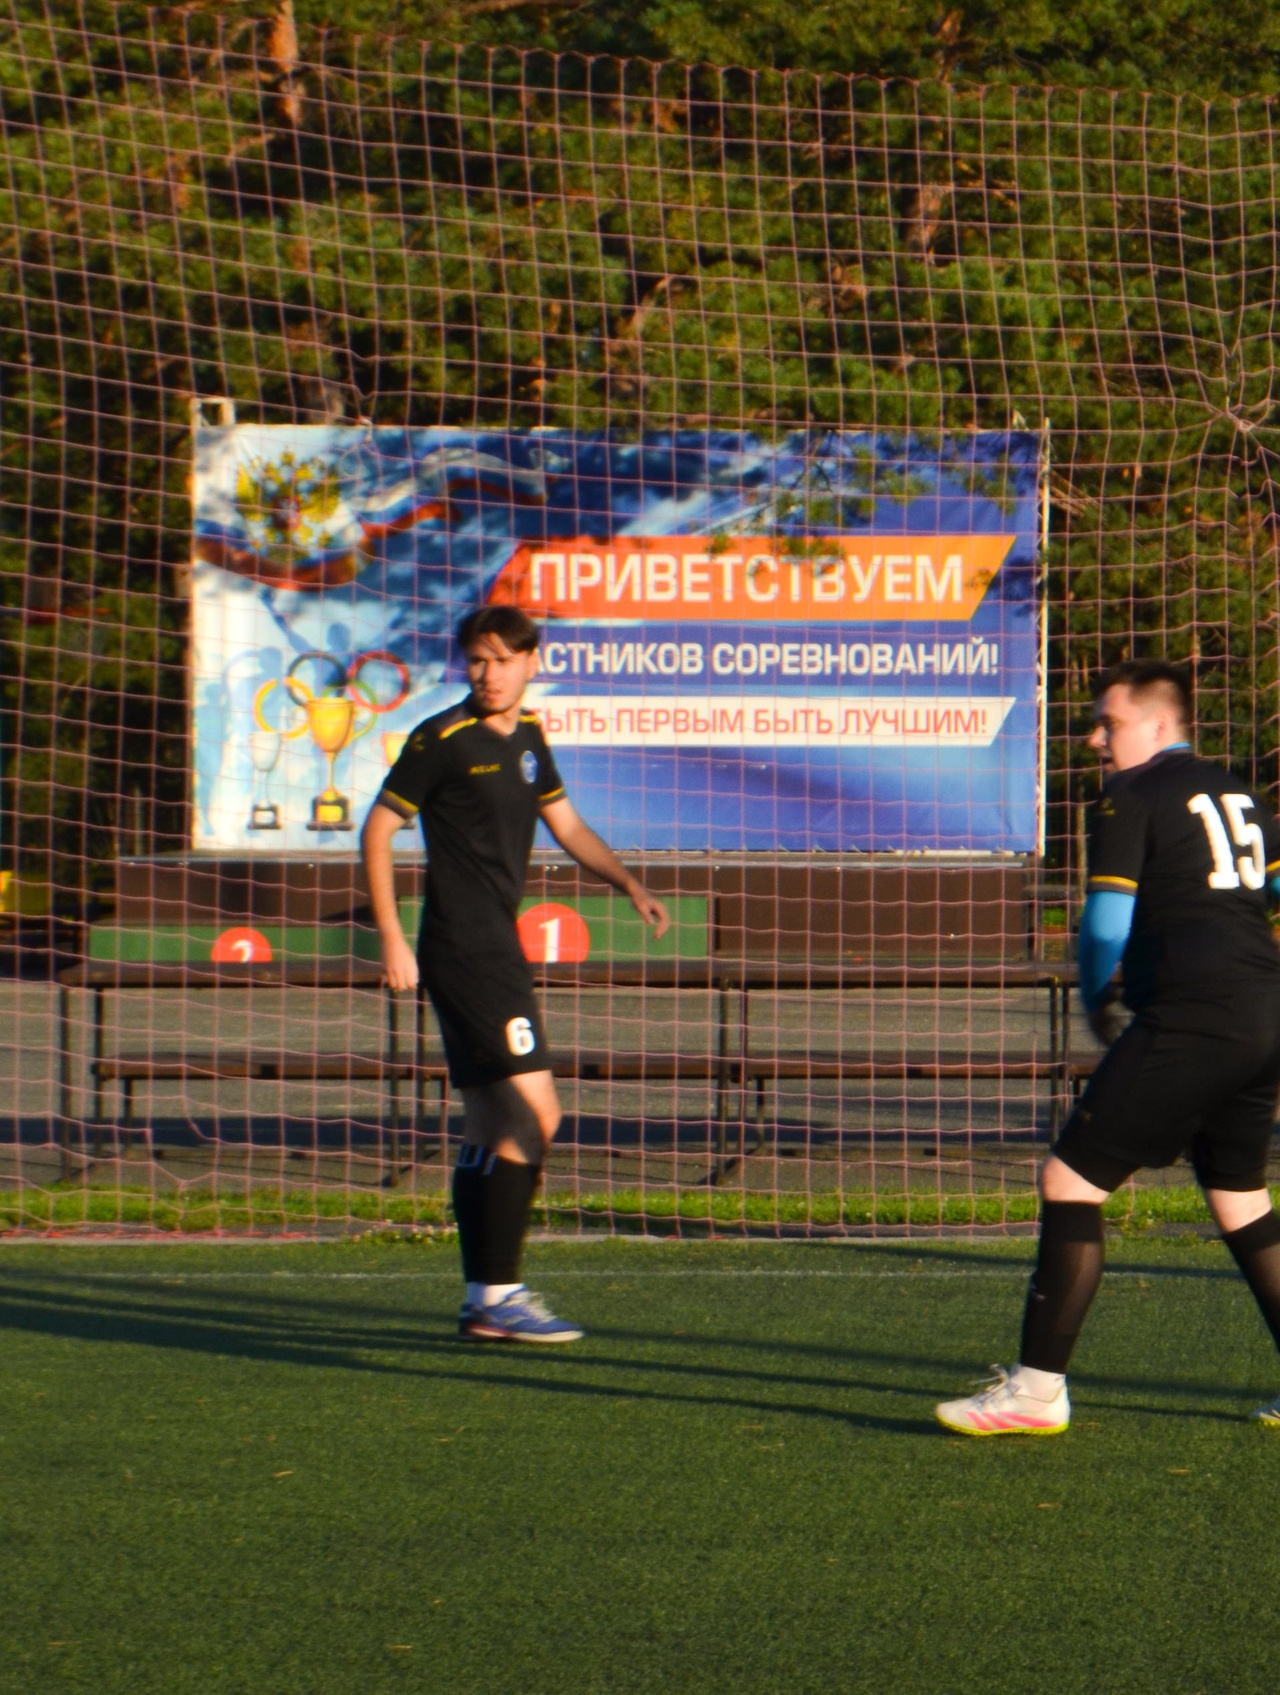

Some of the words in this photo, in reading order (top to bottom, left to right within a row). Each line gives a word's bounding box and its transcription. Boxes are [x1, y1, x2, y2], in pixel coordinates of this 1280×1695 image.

[531, 553, 963, 602] ПРИВЕТСТВУЕМ
[712, 636, 999, 675] СОРЕВНОВАНИЙ!
[615, 707, 744, 733] ПЕРВЫМ
[753, 708, 833, 734] БЫТЬ
[840, 708, 987, 735] ЛУЧШИМ!
[1187, 793, 1265, 889] 15
[539, 917, 560, 962] 1
[507, 1017, 535, 1056] 6
